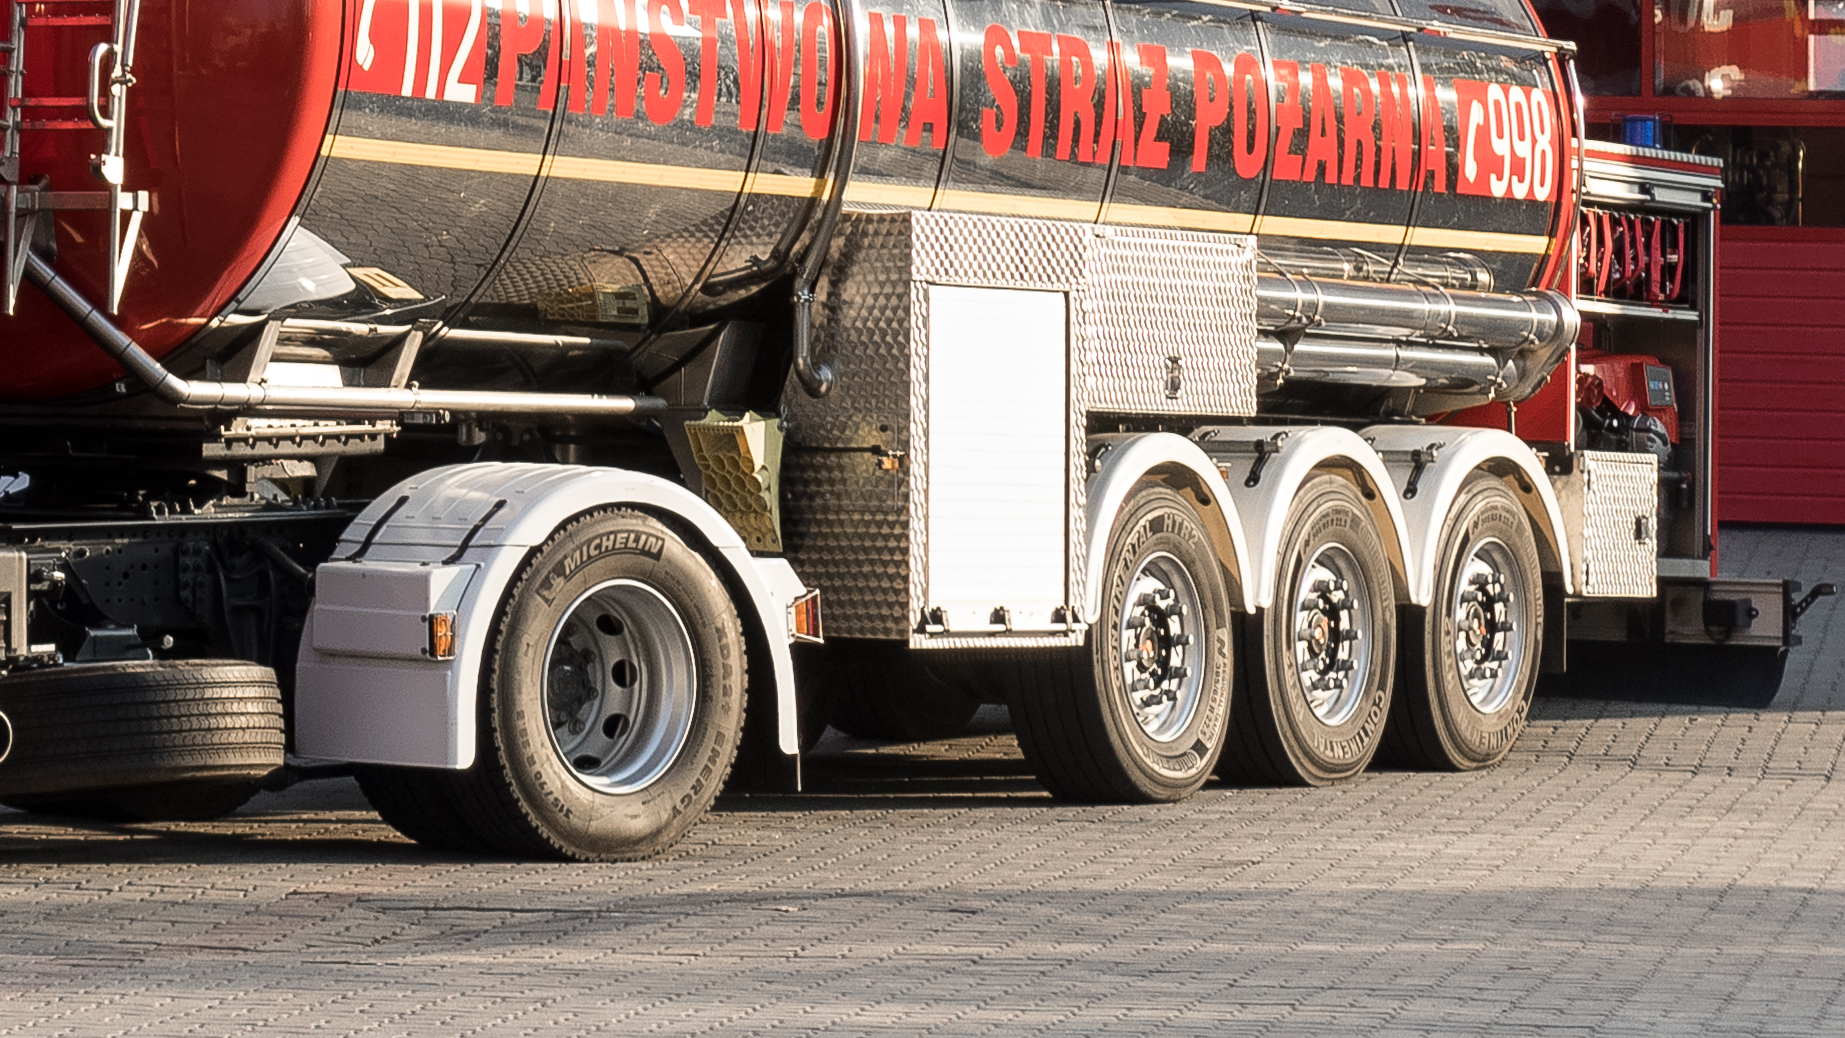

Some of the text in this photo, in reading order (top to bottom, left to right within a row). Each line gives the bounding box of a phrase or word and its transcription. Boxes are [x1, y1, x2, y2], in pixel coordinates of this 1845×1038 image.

[1487, 83, 1555, 202] 998
[563, 533, 665, 577] MICHELIN
[1162, 512, 1201, 551] HTR2
[672, 729, 726, 821] ENERGY
